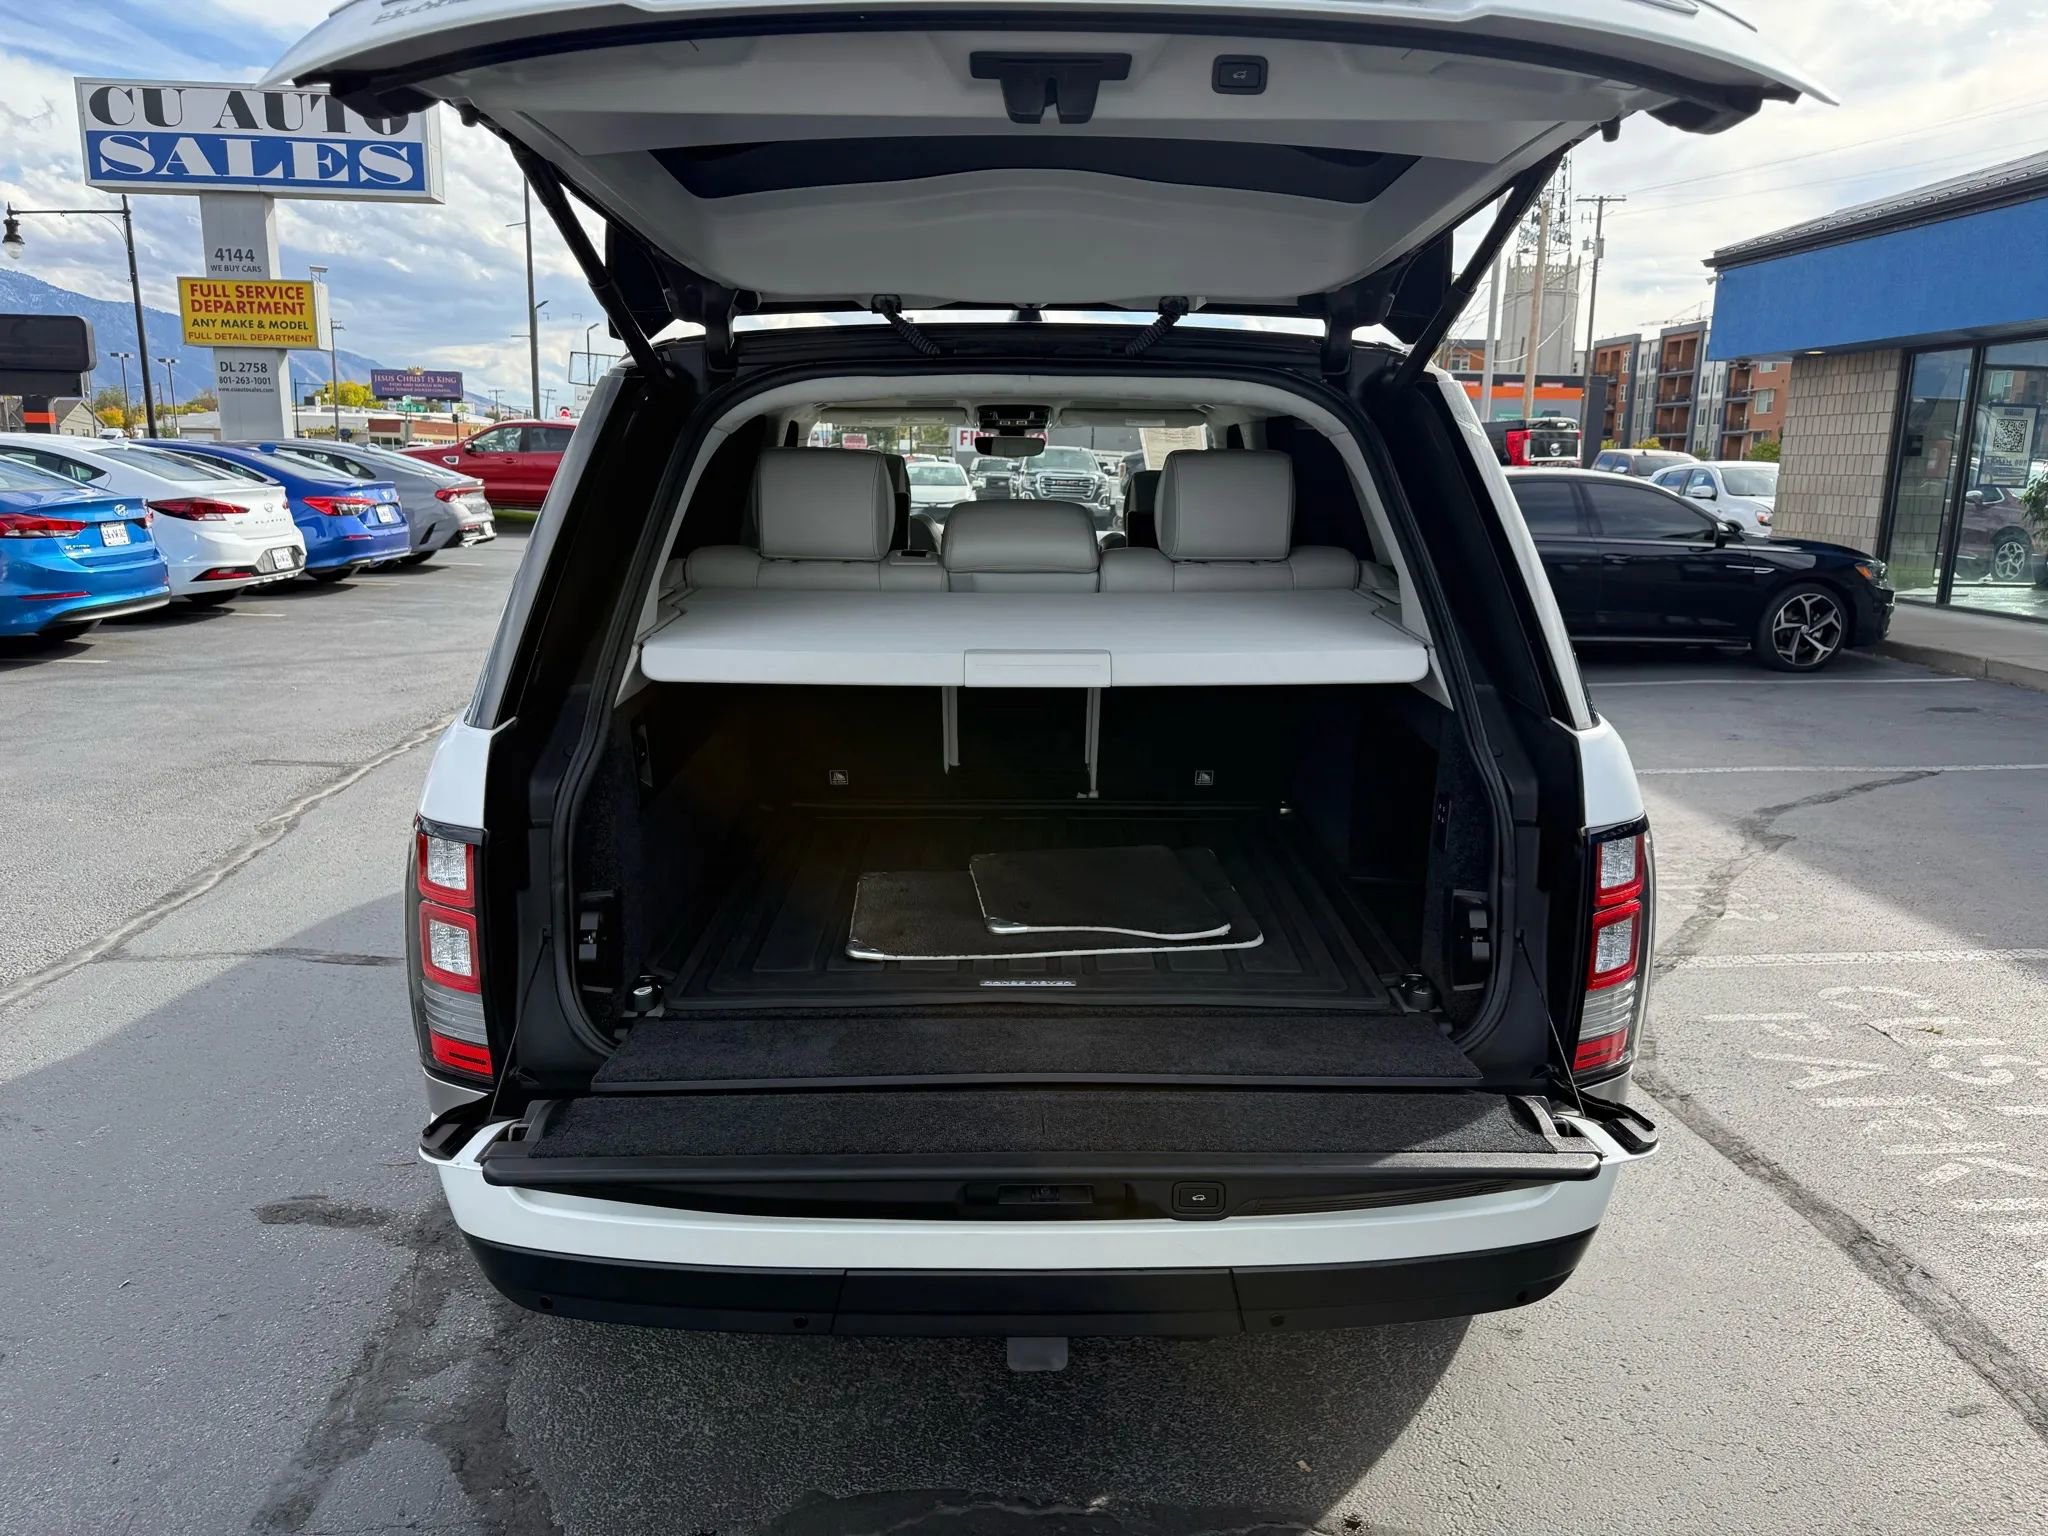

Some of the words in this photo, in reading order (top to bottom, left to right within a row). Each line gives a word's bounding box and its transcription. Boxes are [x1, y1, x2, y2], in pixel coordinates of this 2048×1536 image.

[89, 86, 186, 127] CU
[99, 134, 414, 185] SALES
[214, 248, 255, 262] 4144
[210, 264, 222, 272] WE
[242, 265, 262, 273] CARS
[190, 284, 230, 298] FULL
[235, 285, 304, 300] SERVICE
[191, 299, 306, 315] DEPARTMENT
[191, 318, 217, 328] ANY
[221, 319, 254, 328] MAKE
[257, 320, 265, 329] &
[269, 320, 309, 330] MODEL
[188, 332, 211, 340] FULL
[214, 333, 248, 341] DETAIL
[251, 334, 313, 343] DEPARTMENT
[220, 361, 236, 373] DL
[239, 362, 268, 374] 2758
[219, 376, 271, 385] 801-263-1001
[374, 374, 395, 383] JESUS
[396, 374, 425, 383] CHRIST
[427, 375, 435, 383] IS
[436, 375, 457, 384] KING
